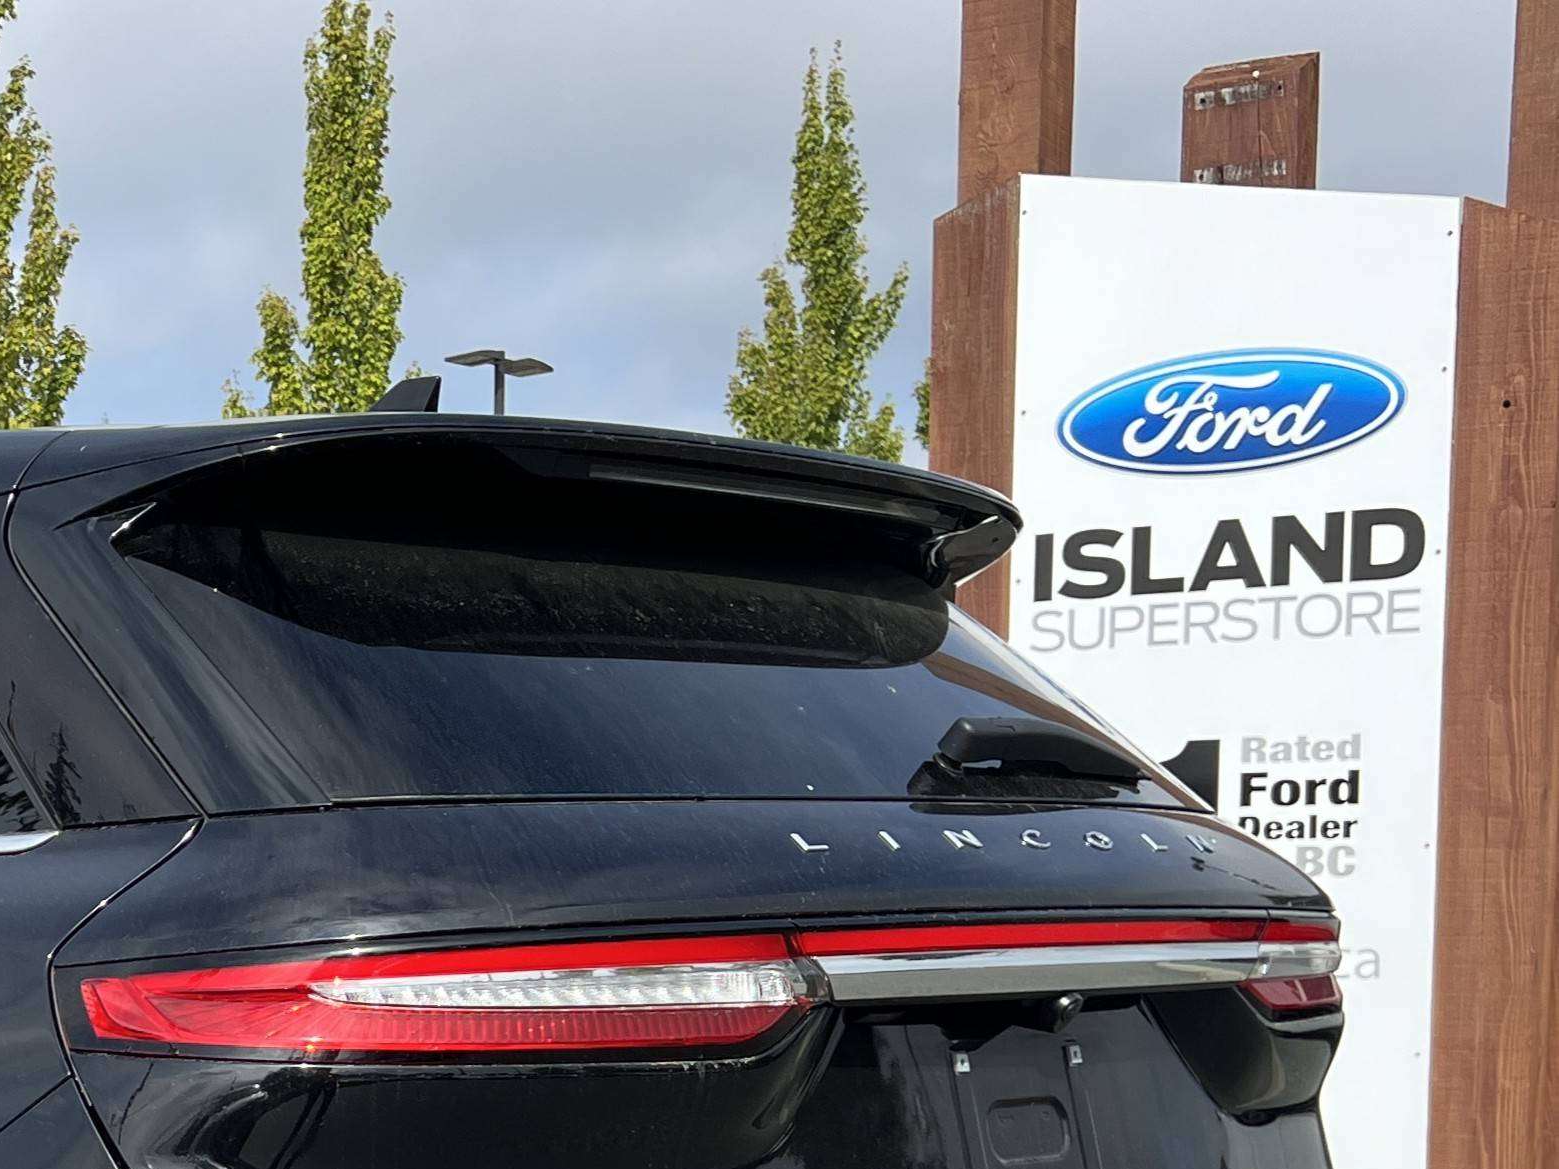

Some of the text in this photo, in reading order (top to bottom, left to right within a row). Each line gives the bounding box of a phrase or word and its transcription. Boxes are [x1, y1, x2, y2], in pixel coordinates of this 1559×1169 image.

[1123, 370, 1333, 457] Ford
[1033, 507, 1426, 602] ISLAND
[1030, 588, 1422, 652] SUPERSTORE
[1240, 734, 1361, 763] Rated
[1239, 769, 1360, 807] Ford
[789, 829, 1218, 855] LINCOLN
[1238, 815, 1358, 840] Dealer
[1296, 845, 1356, 878] BC
